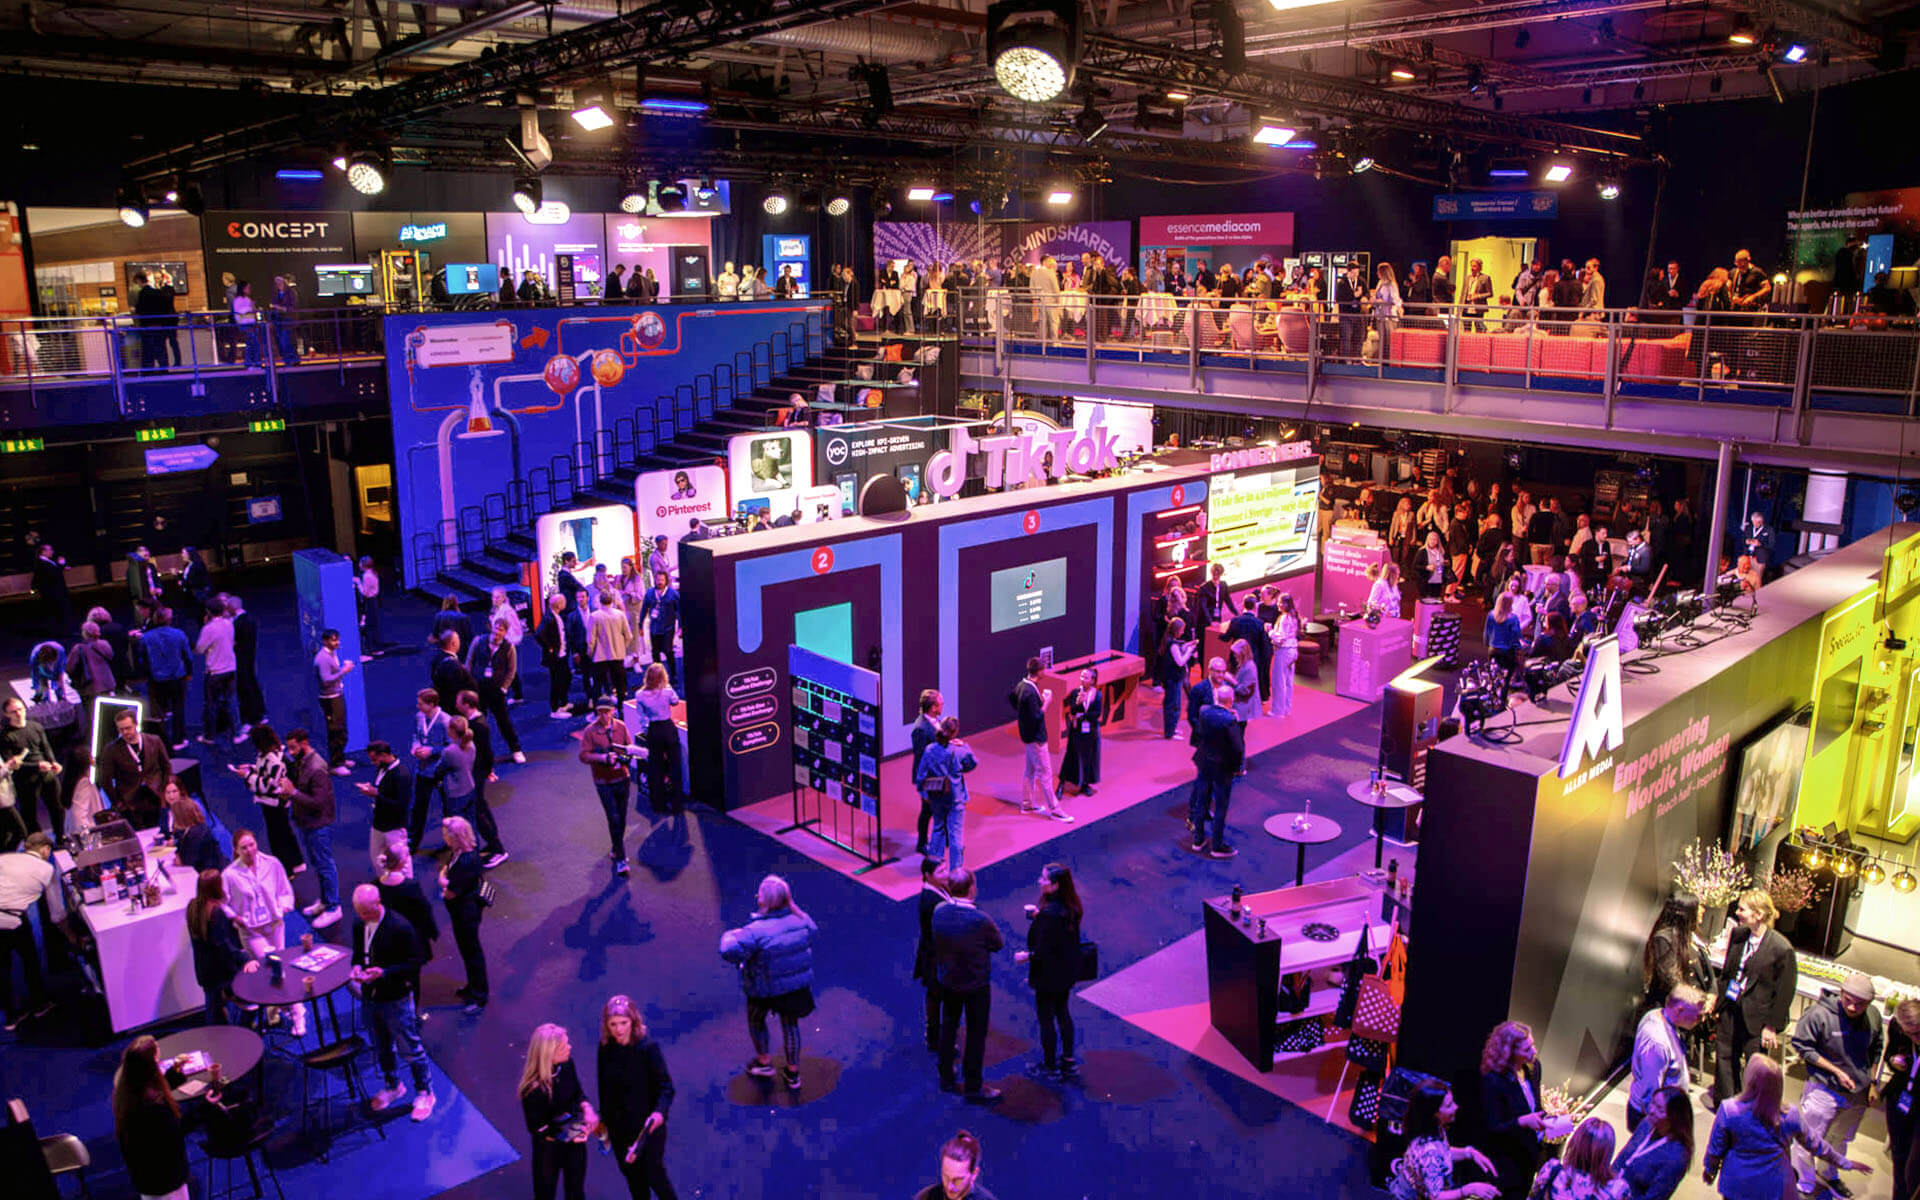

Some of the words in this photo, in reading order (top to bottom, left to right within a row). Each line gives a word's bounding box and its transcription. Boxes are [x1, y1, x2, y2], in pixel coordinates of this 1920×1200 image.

[227, 222, 329, 238] CONCEPT
[1167, 220, 1261, 233] essencemediacom
[852, 439, 875, 449] EXPLORE
[852, 446, 888, 457] HIGH-IMPACT
[889, 441, 925, 453] ADVERTISING
[980, 427, 1119, 488] TikTok
[1174, 489, 1181, 502] 4
[668, 502, 712, 517] Pinterest
[1028, 515, 1036, 529] 3
[818, 552, 828, 569] 2
[1613, 714, 1710, 794] Empowering
[1562, 772, 1588, 797] ALLER
[1588, 755, 1614, 781] MEDIA
[1625, 763, 1678, 820] Nordic
[1680, 732, 1730, 782] Women
